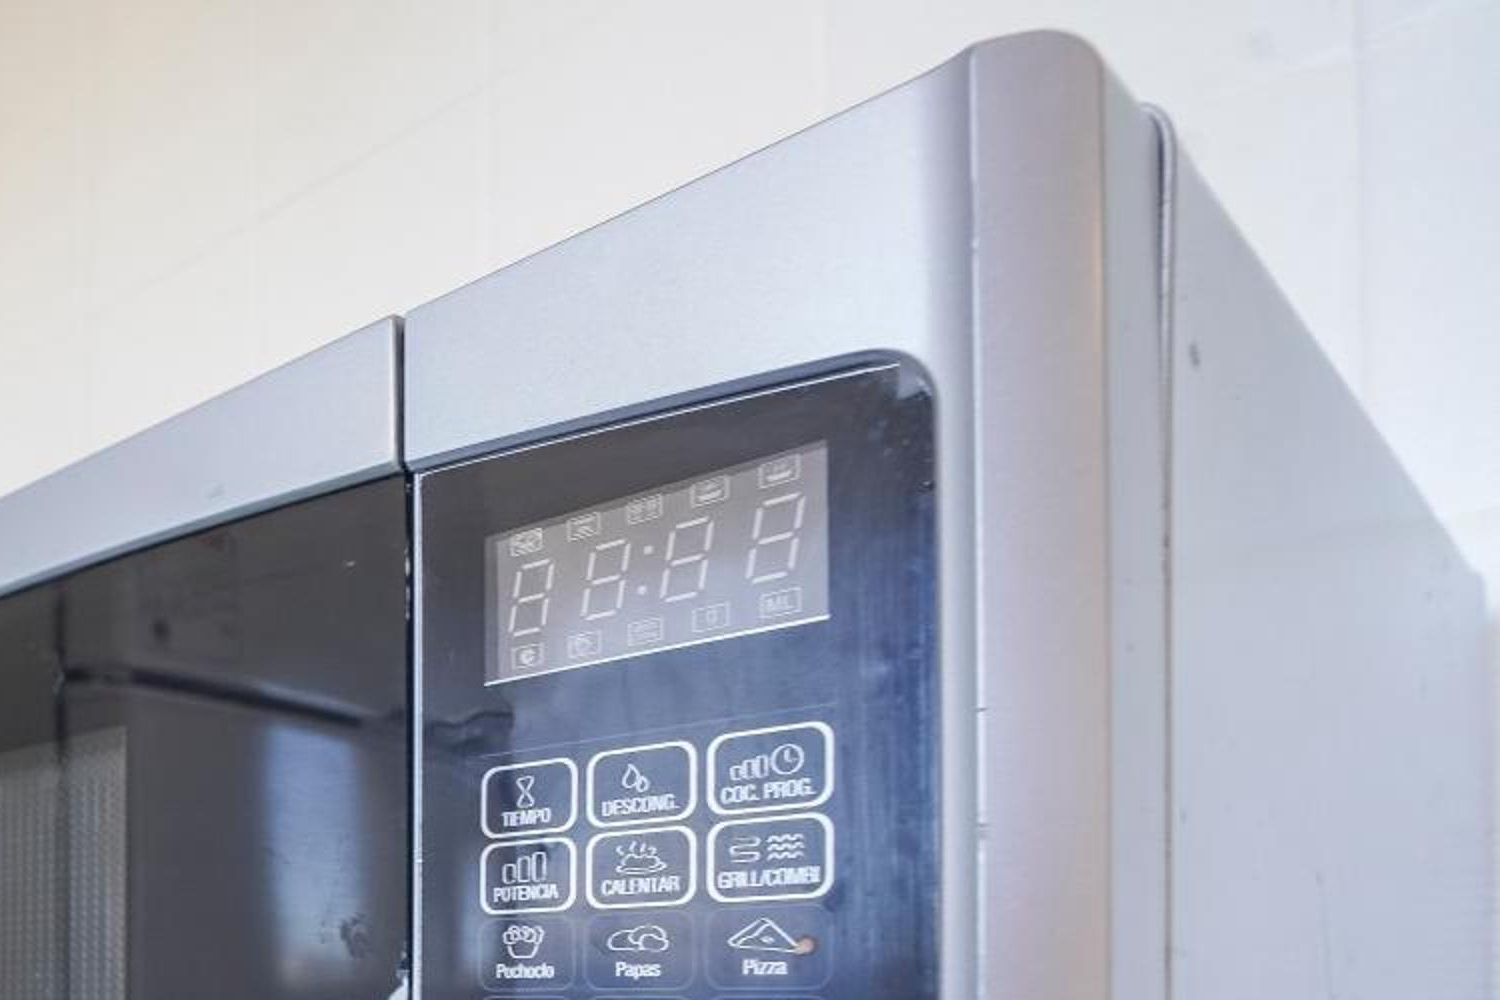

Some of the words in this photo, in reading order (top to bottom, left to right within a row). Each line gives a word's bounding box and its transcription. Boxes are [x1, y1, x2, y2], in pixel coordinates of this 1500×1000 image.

[720, 783, 760, 804] COC.
[762, 777, 818, 800] PROG.
[501, 807, 551, 827] TIEMPO
[493, 883, 559, 903] POTENCIA
[601, 874, 681, 897] CALENTAR
[615, 961, 661, 980] Papas
[742, 959, 788, 976] Pizza
